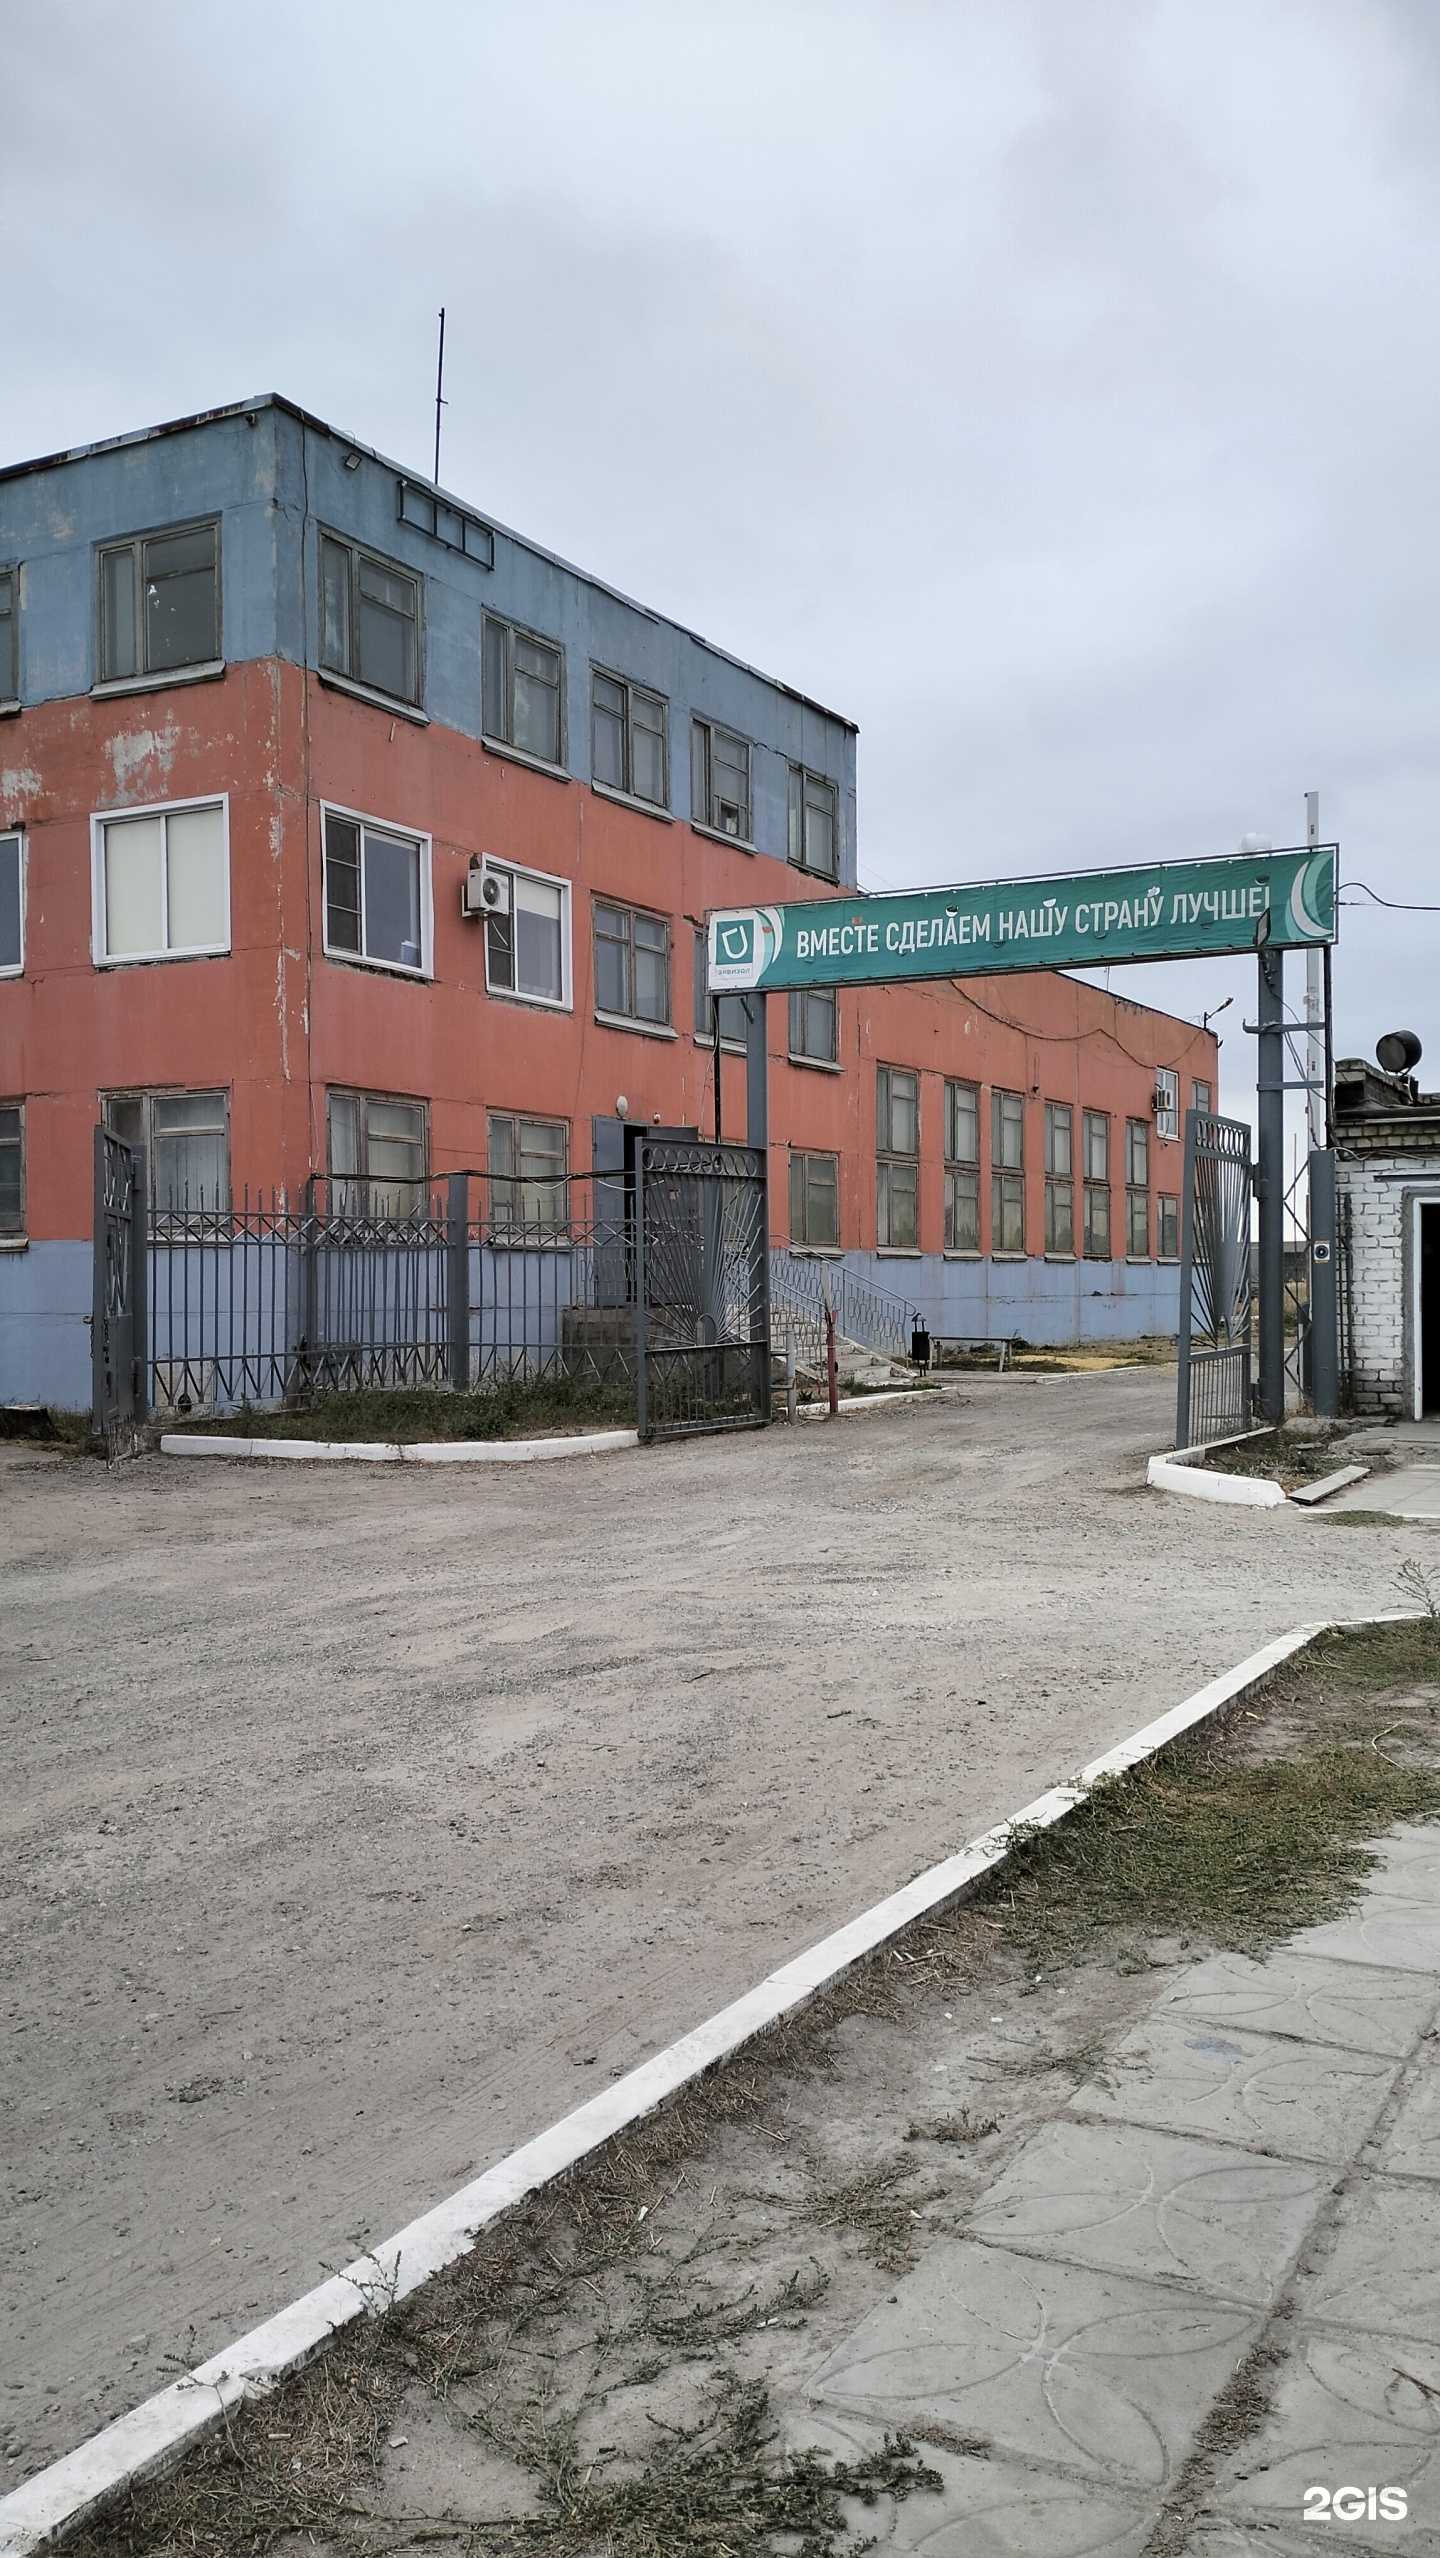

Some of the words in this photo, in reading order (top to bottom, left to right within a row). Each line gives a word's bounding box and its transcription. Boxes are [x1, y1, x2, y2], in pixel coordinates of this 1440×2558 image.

[797, 924, 879, 958] ВМЕСТЕ
[886, 912, 990, 953] СДЕЛАЕМ
[999, 905, 1068, 940] НАШУ
[1075, 895, 1164, 933] СТРАНУ
